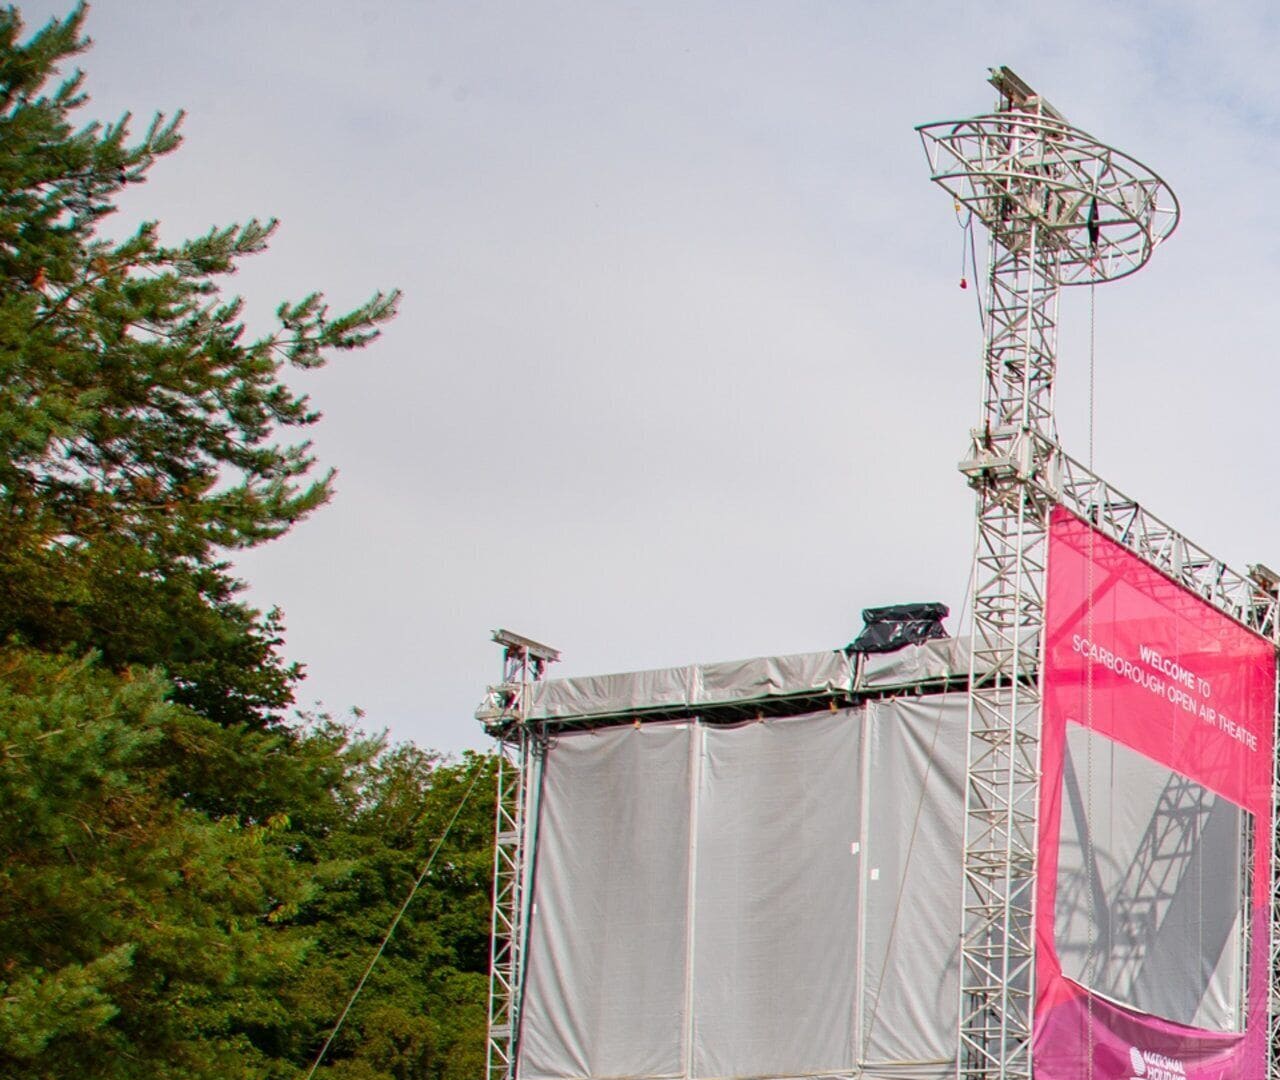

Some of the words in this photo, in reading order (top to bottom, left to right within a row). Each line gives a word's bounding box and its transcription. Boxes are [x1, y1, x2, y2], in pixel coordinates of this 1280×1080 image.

[1072, 634, 1165, 697] SCARBOROUGH
[1167, 685, 1197, 715] OPEN
[1199, 703, 1216, 726] AIR
[1218, 714, 1258, 752] THEATRE
[1139, 643, 1195, 690] WELCOME
[1197, 675, 1211, 698] TO
[1143, 1050, 1186, 1074] NATIONAL
